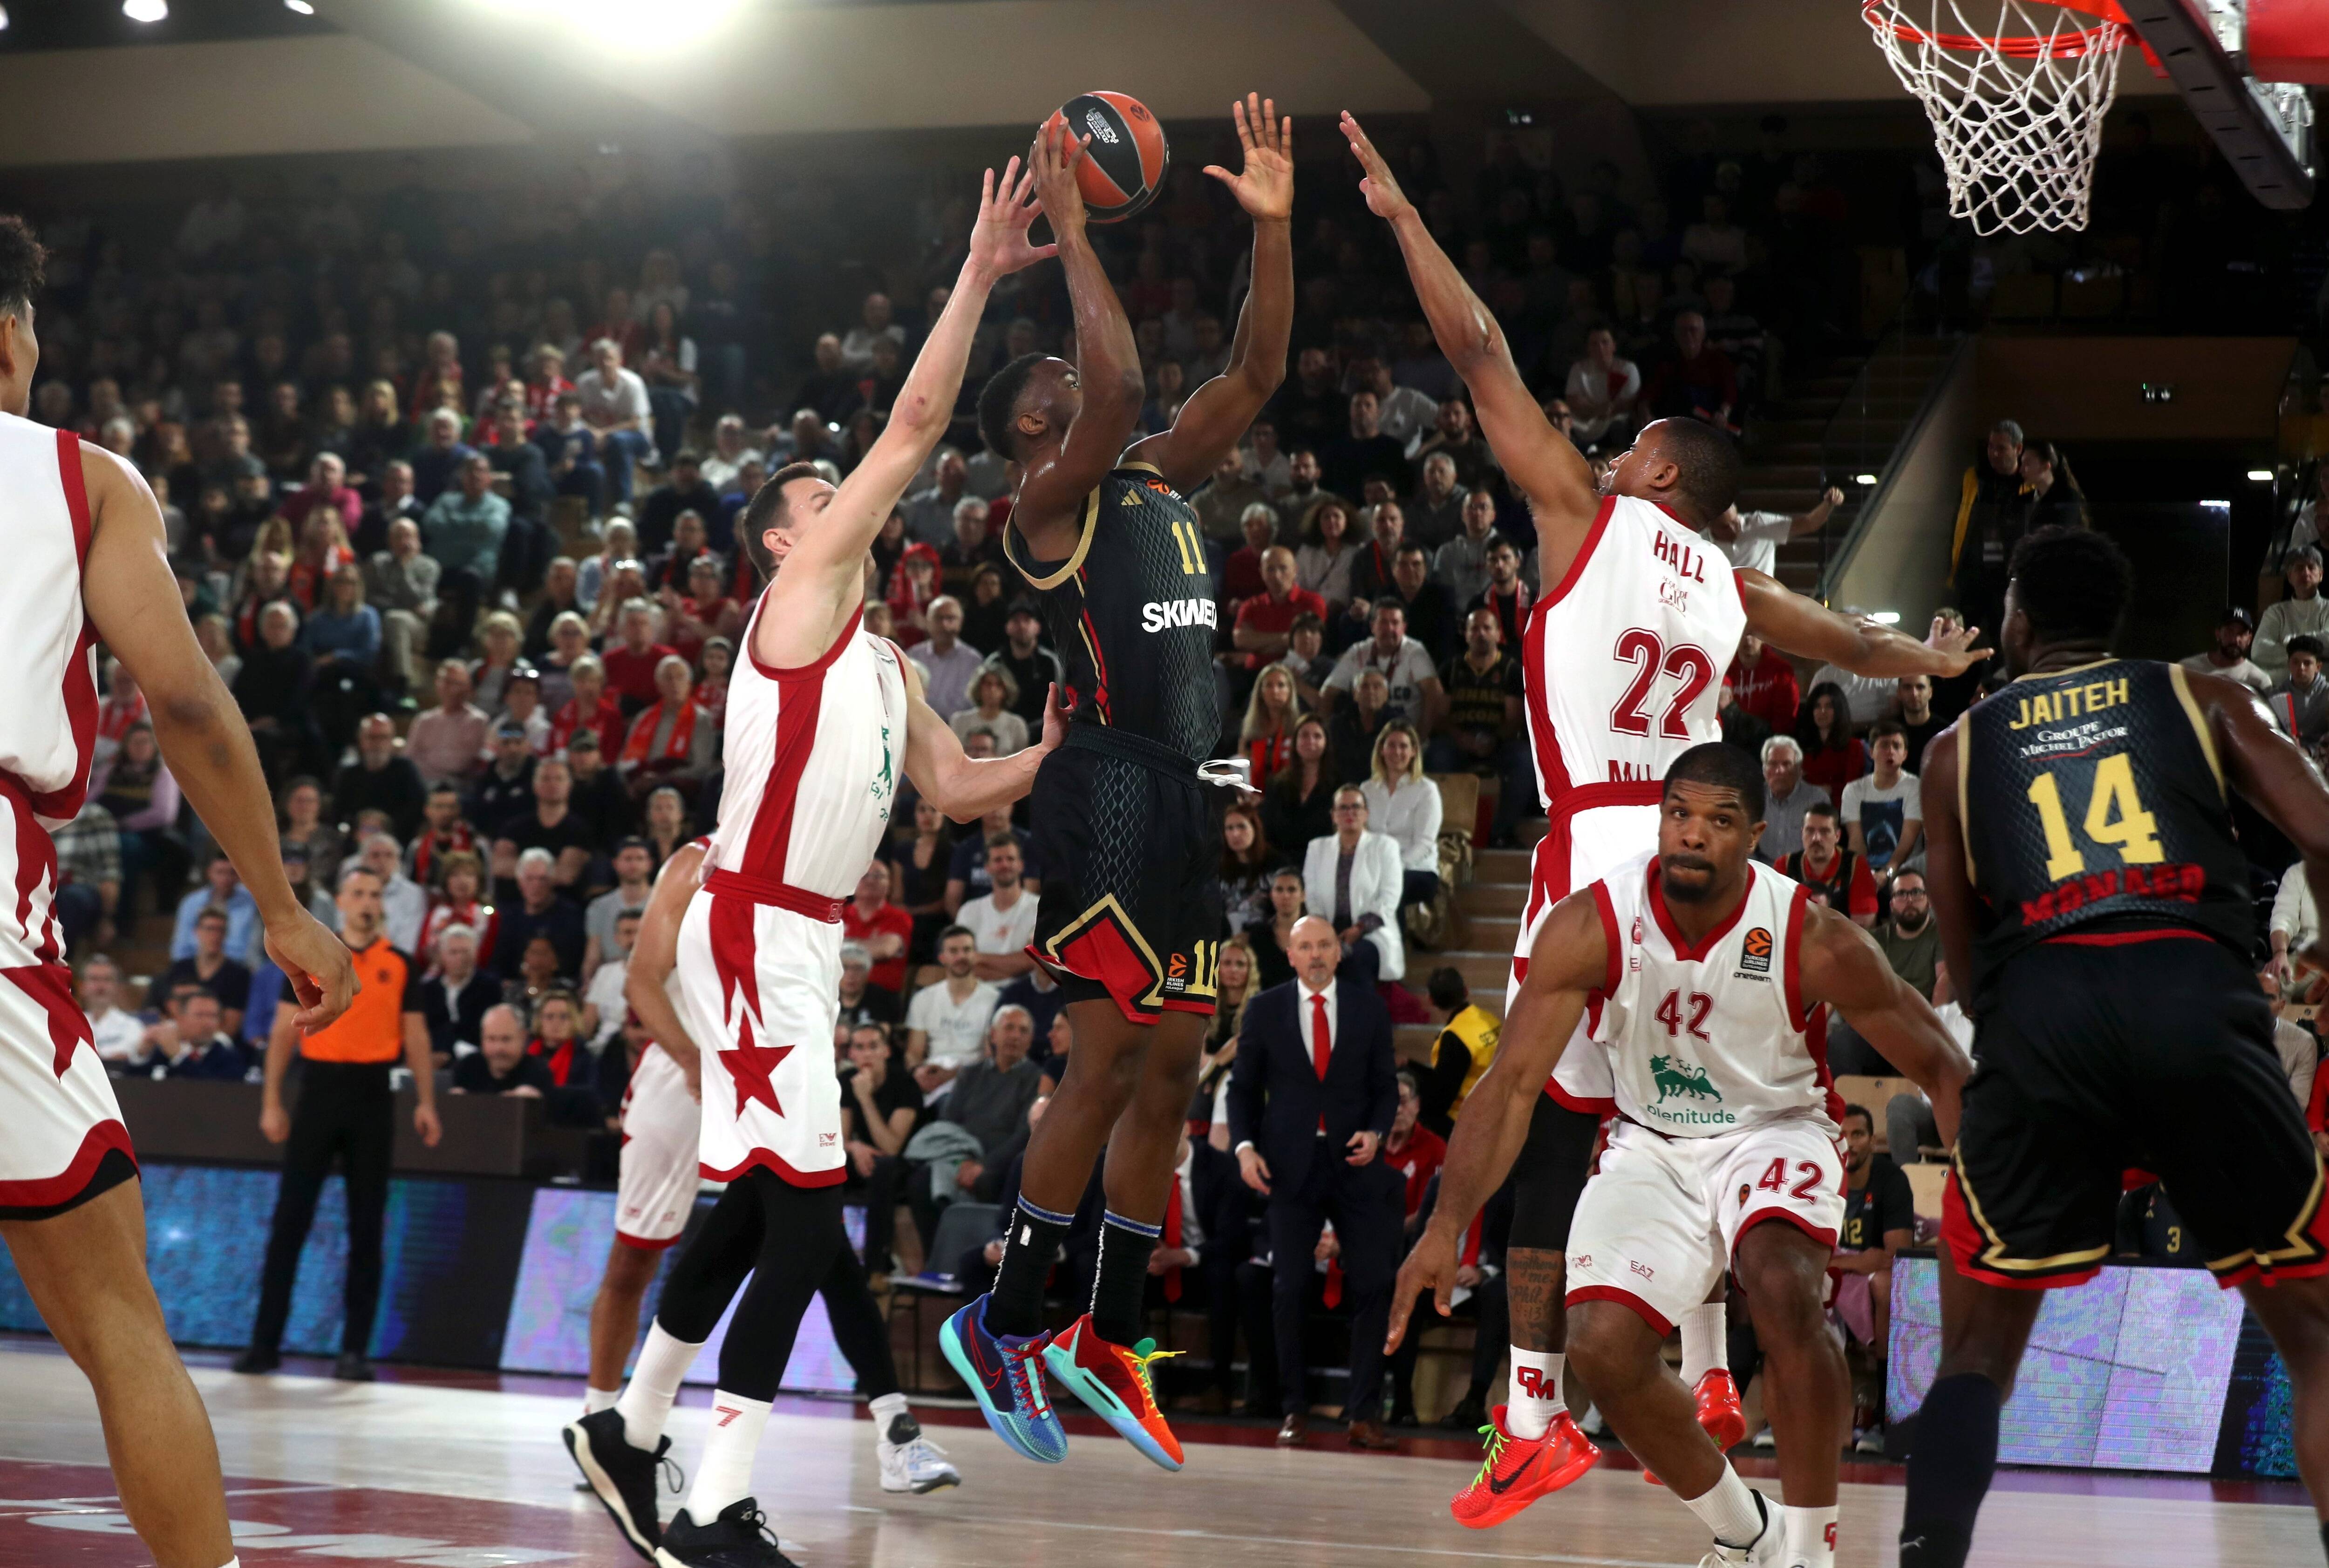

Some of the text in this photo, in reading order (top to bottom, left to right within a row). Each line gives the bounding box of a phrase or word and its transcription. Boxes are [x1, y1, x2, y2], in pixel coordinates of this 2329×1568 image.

[1088, 108, 1119, 143] LEGACY
[1171, 522, 1206, 574] 11
[1654, 530, 1704, 584] HALL
[1610, 627, 1716, 741] 22
[2009, 678, 2130, 730] JAITEH
[2019, 726, 2129, 759] MICHEL PASTOR
[2037, 721, 2102, 742] GROUPE
[2027, 752, 2166, 882] 14
[1190, 939, 1217, 998] 11
[1733, 971, 1772, 983] oneteam
[1655, 987, 1713, 1043] 42
[1647, 1104, 1737, 1124] plenitude
[1756, 1157, 1824, 1205] 42
[2166, 1226, 2181, 1253] 3
[1630, 1260, 1655, 1278] EA7
[715, 1405, 743, 1427] 7
